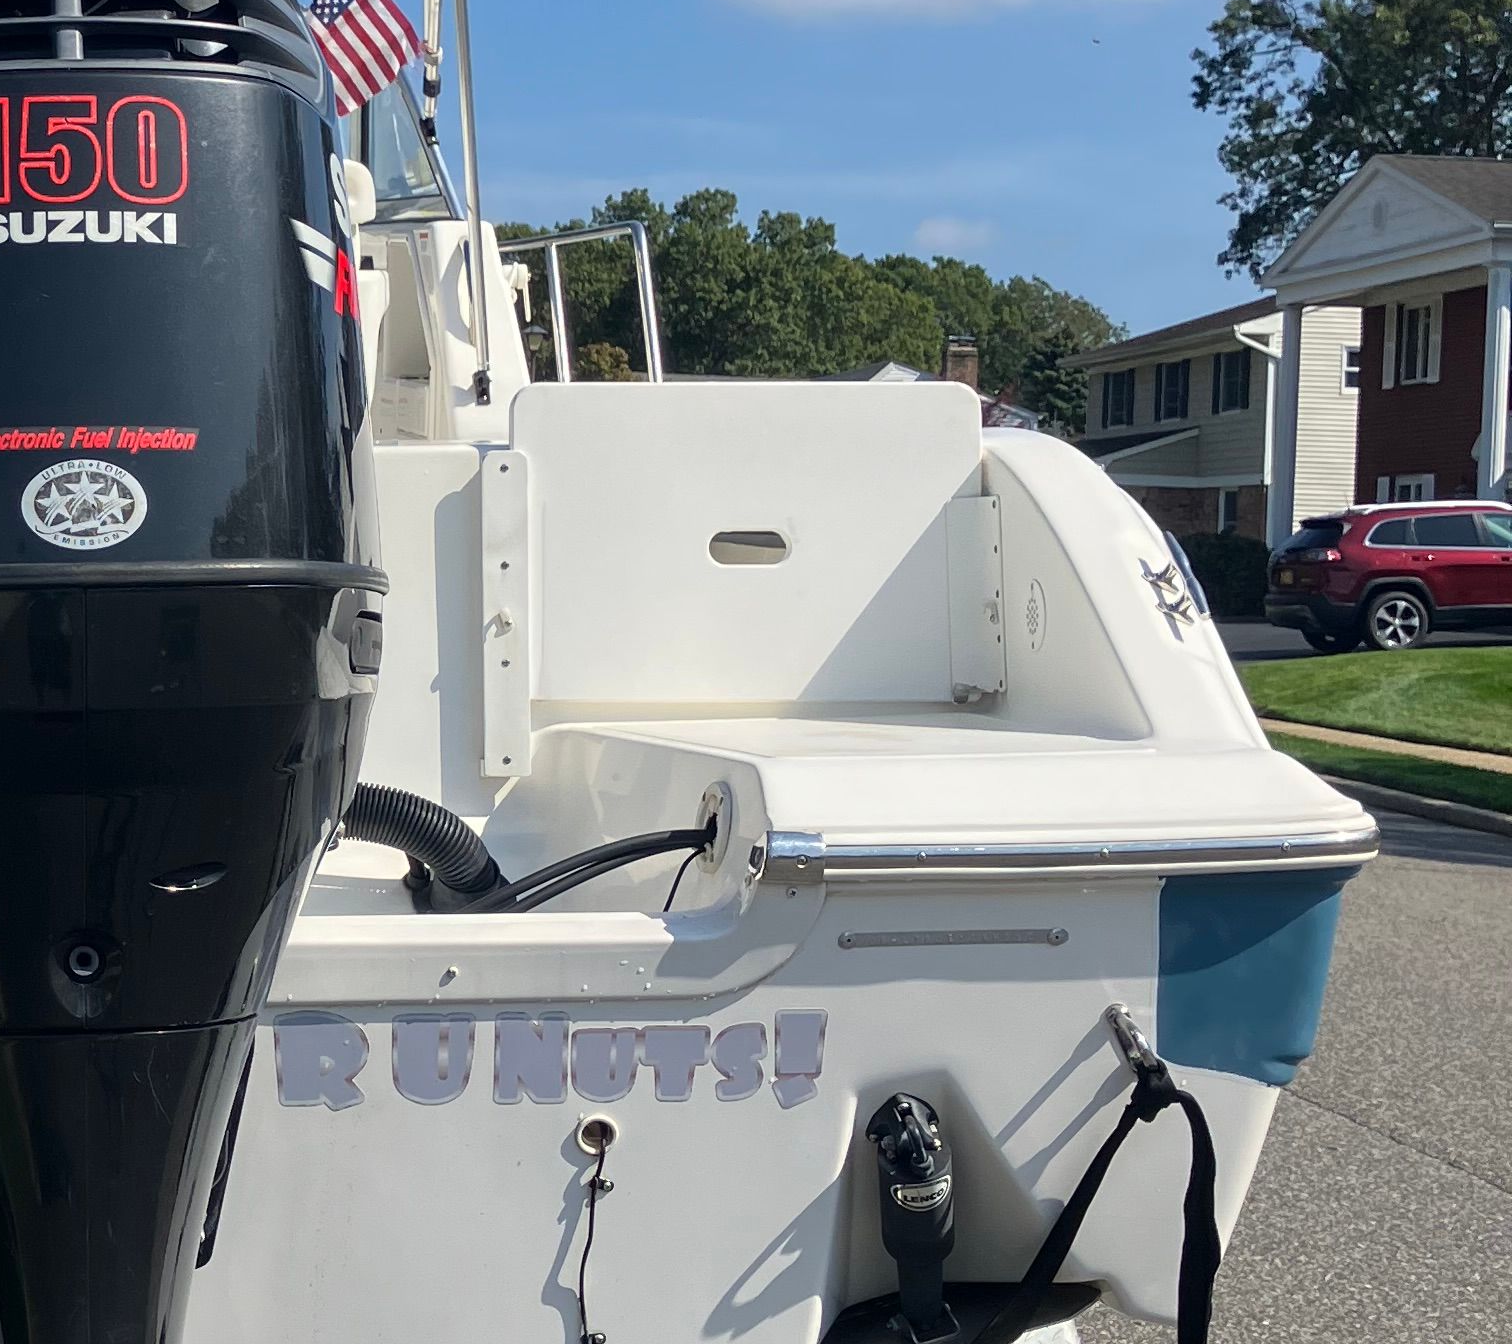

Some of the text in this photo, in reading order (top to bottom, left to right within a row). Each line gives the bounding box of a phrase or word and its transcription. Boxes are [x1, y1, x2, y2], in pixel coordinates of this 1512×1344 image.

[70, 426, 115, 450] Fuel
[116, 426, 199, 455] Injection
[41, 461, 127, 481] ULTRA LOW
[53, 532, 121, 546] EMISSION
[273, 1010, 370, 1112] R
[391, 1011, 477, 1106] U
[903, 1187, 945, 1204] LENCO
